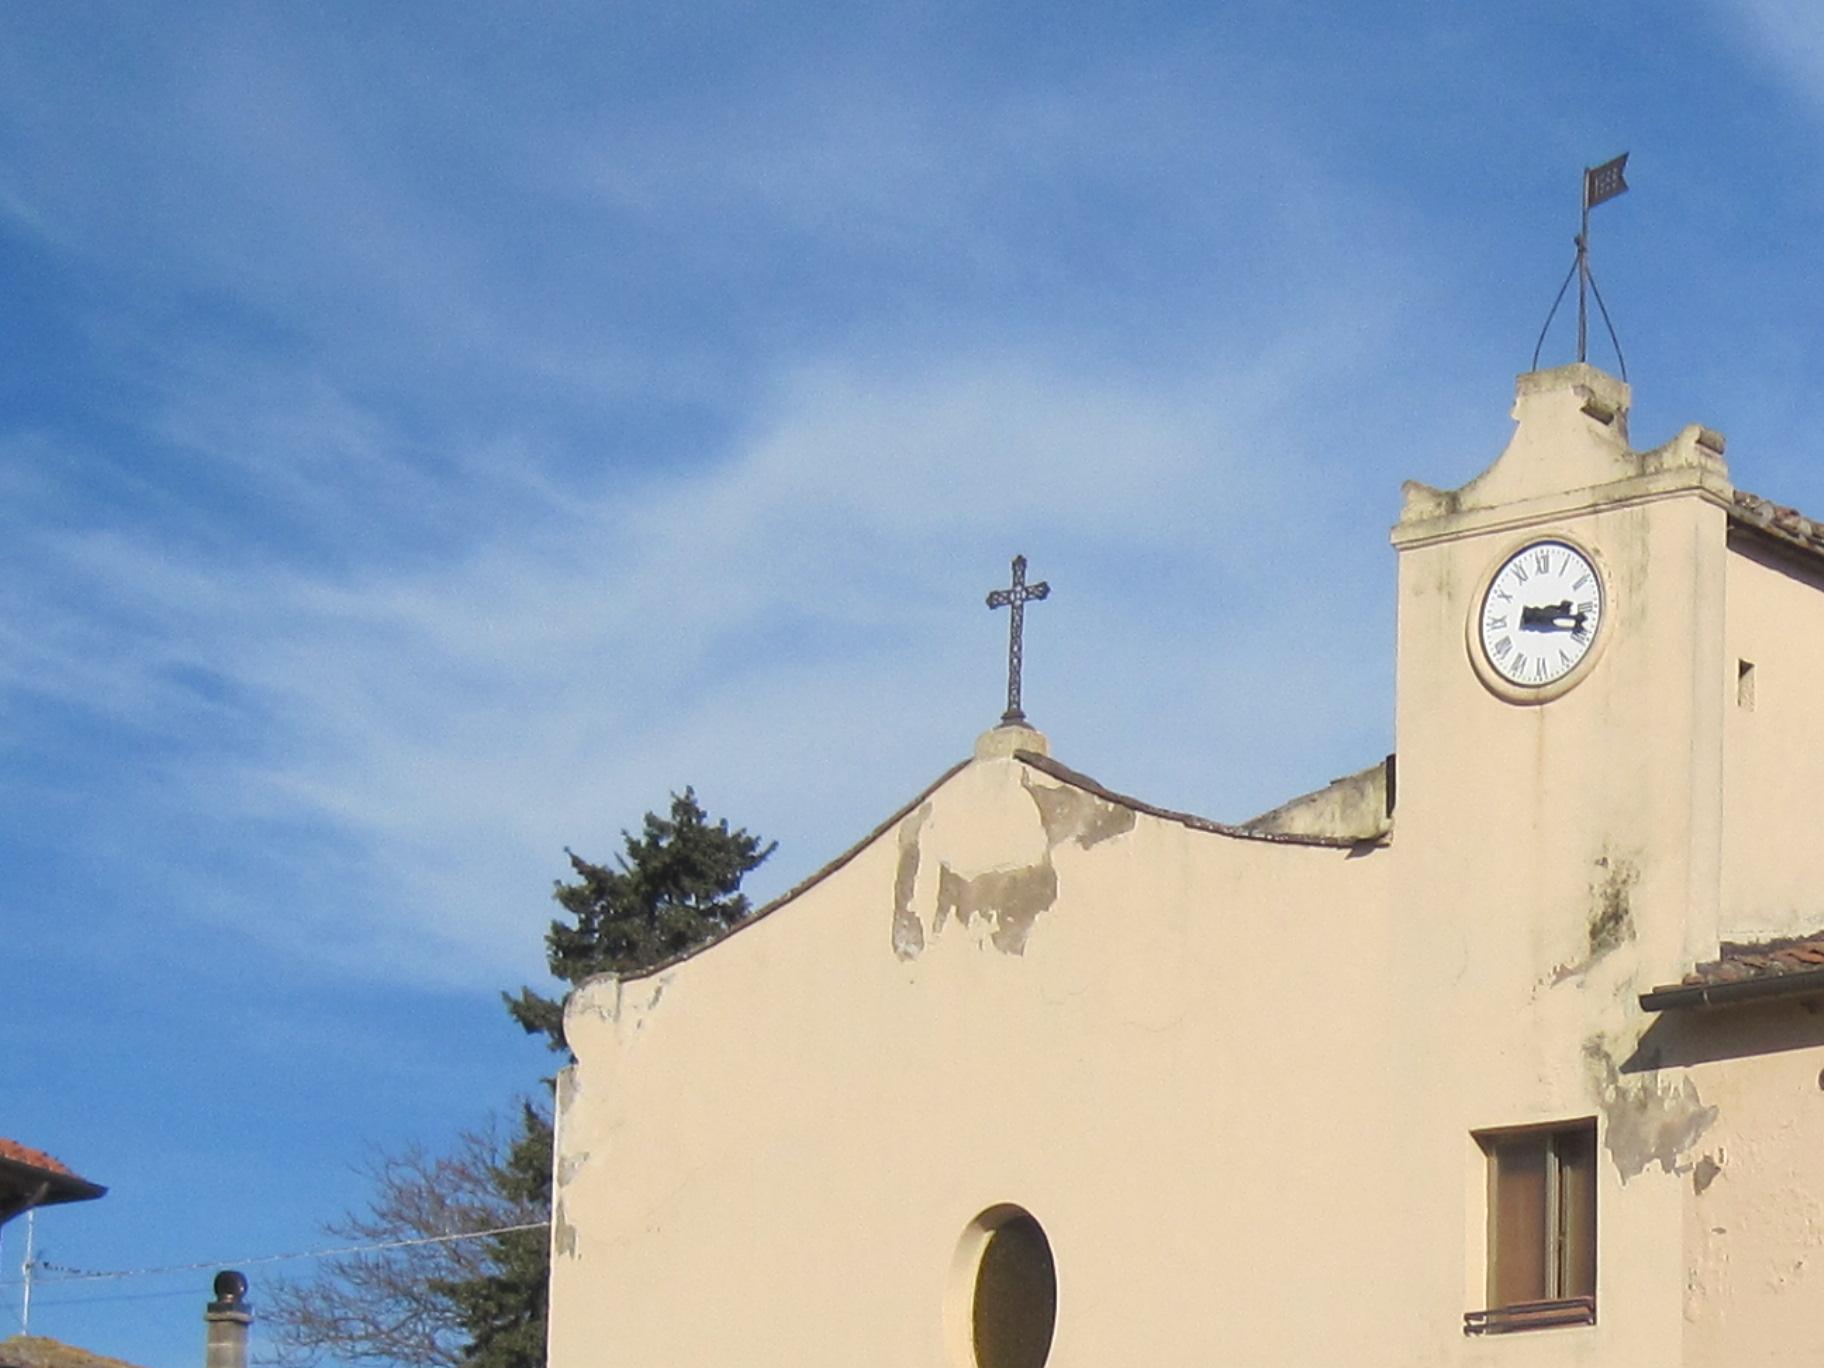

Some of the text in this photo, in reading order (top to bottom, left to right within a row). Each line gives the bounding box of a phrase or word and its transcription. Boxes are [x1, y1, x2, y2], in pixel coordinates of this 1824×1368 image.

[1536, 553, 1550, 574] XII
[1560, 553, 1571, 577] I
[1573, 574, 1591, 591] II
[1497, 589, 1513, 602] X
[1577, 602, 1593, 613] III
